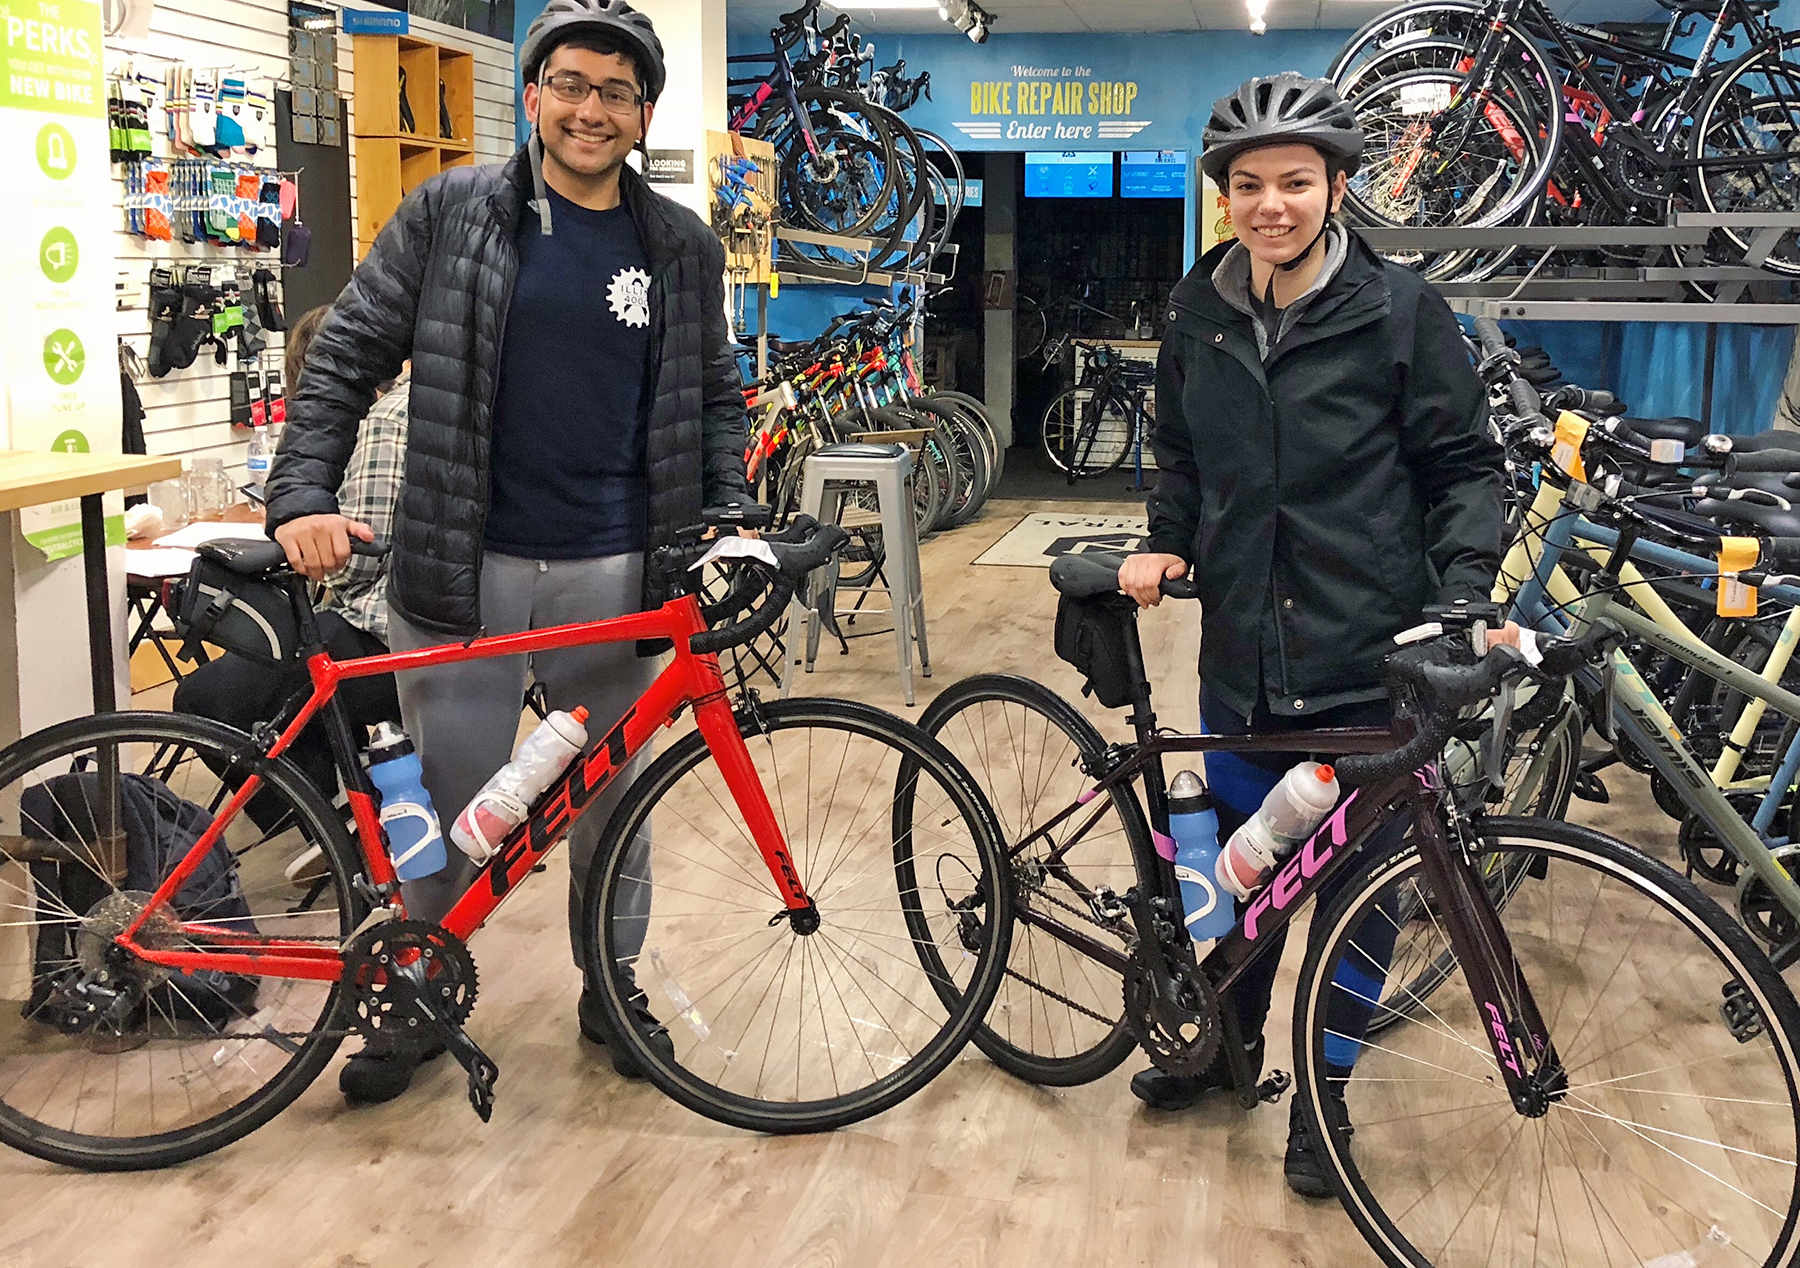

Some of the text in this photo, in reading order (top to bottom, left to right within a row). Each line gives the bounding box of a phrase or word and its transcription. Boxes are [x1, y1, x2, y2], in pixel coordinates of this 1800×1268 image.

[38, 2, 60, 20] THE
[8, 16, 90, 60] PERKS
[10, 74, 94, 105] NEW BIKE
[1011, 65, 1092, 77] Welcome to the
[970, 82, 1138, 115] BIKE REPAIR SHOP
[1006, 120, 1092, 139] Enter here
[649, 159, 687, 167] LOOKING
[490, 704, 638, 898] FELT
[961, 780, 990, 823] ZAFFIRO
[774, 850, 807, 905] FELT
[1243, 787, 1360, 942] FELT
[1484, 1001, 1522, 1080] FELT
